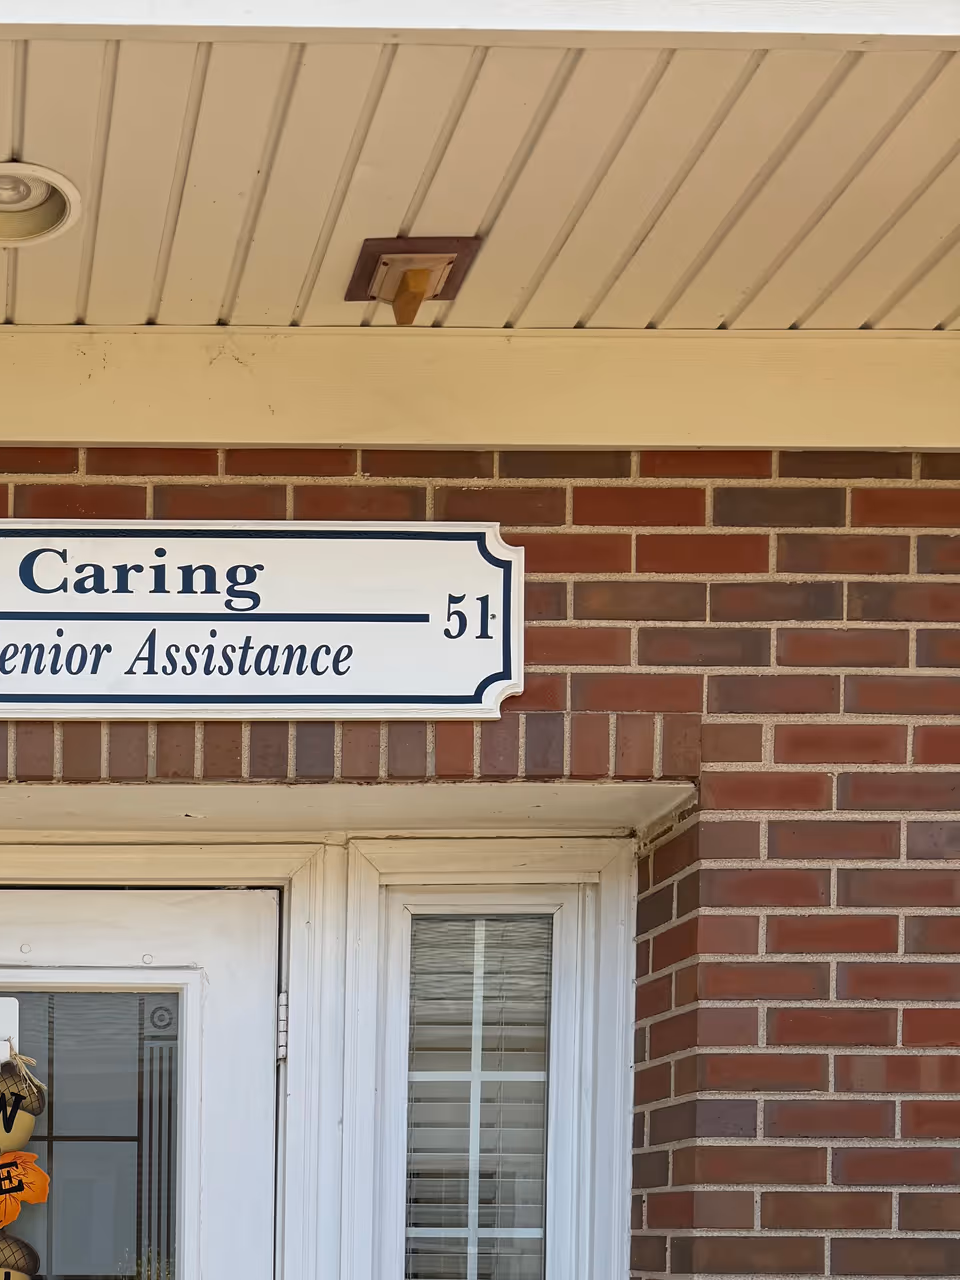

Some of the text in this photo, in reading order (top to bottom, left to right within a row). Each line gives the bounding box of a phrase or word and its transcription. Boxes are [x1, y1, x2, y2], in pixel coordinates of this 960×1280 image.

[18, 547, 265, 612] Caring
[443, 593, 494, 640] 51
[123, 627, 354, 677] Assistance
